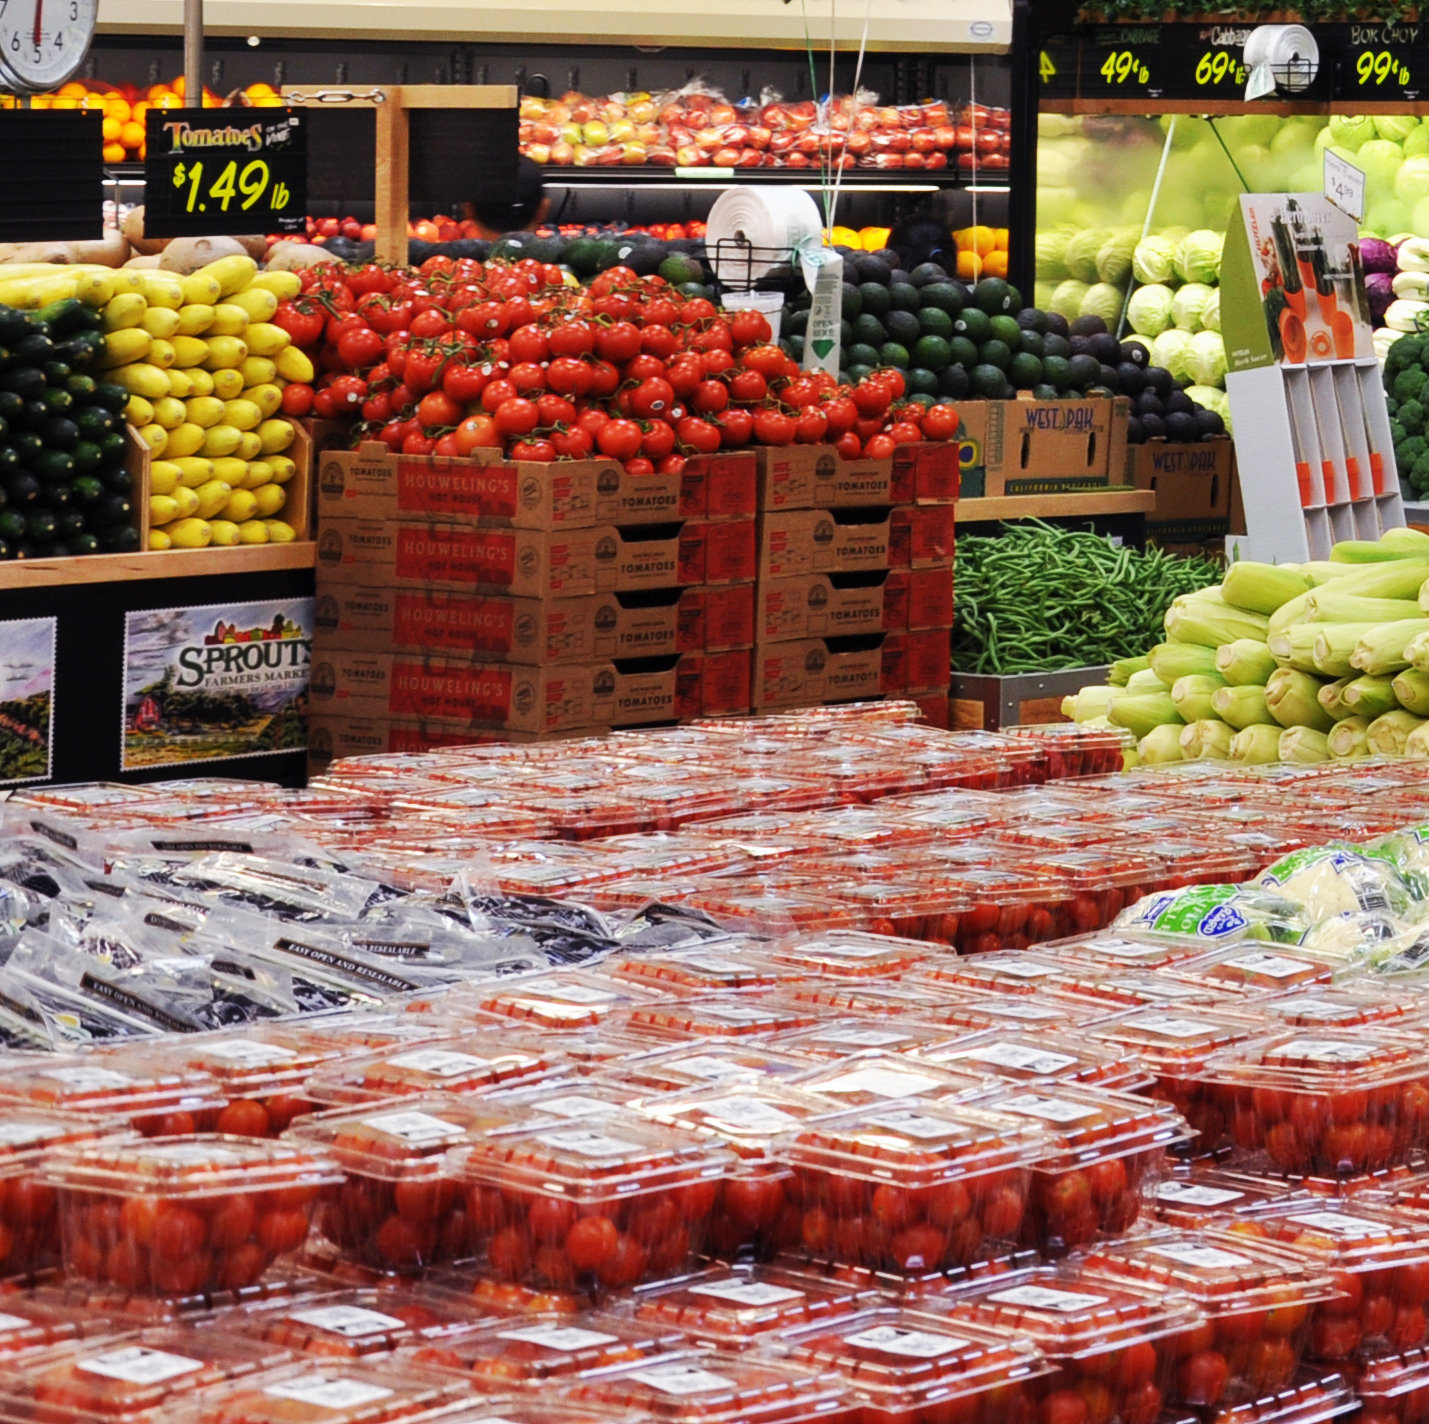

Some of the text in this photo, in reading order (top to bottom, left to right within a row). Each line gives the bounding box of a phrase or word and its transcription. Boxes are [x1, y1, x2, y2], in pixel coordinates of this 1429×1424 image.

[70, 2, 78, 21] 3
[11, 32, 20, 51] 6
[54, 32, 63, 50] 4
[1351, 25, 1418, 45] BOK CHOY
[1101, 51, 1149, 83] 49¢ lb
[1196, 52, 1236, 84] 69¢
[1357, 51, 1410, 85] 99¢ lb
[173, 160, 289, 212] $1.49 lb
[1026, 408, 1094, 430] WEST PAK
[404, 475, 510, 494] HOUWELING'S
[837, 480, 888, 491] TOMATOES
[622, 495, 677, 507] TOMATOES
[404, 541, 508, 561] HOUWELING'S
[836, 545, 886, 556] TOMATOES
[621, 560, 676, 574] TOMATOES
[403, 608, 506, 628] HOUWELING'S
[831, 608, 880, 620] TOMATOES
[620, 629, 675, 644] TOMATOES
[205, 674, 261, 688] FARMERS
[265, 668, 308, 681] MARKE
[400, 676, 505, 697] HOUWELING'S
[618, 693, 673, 709] TOMATOES
[288, 943, 410, 990] EASY OPEN AND RESEALABLE
[93, 982, 112, 996] EASY
